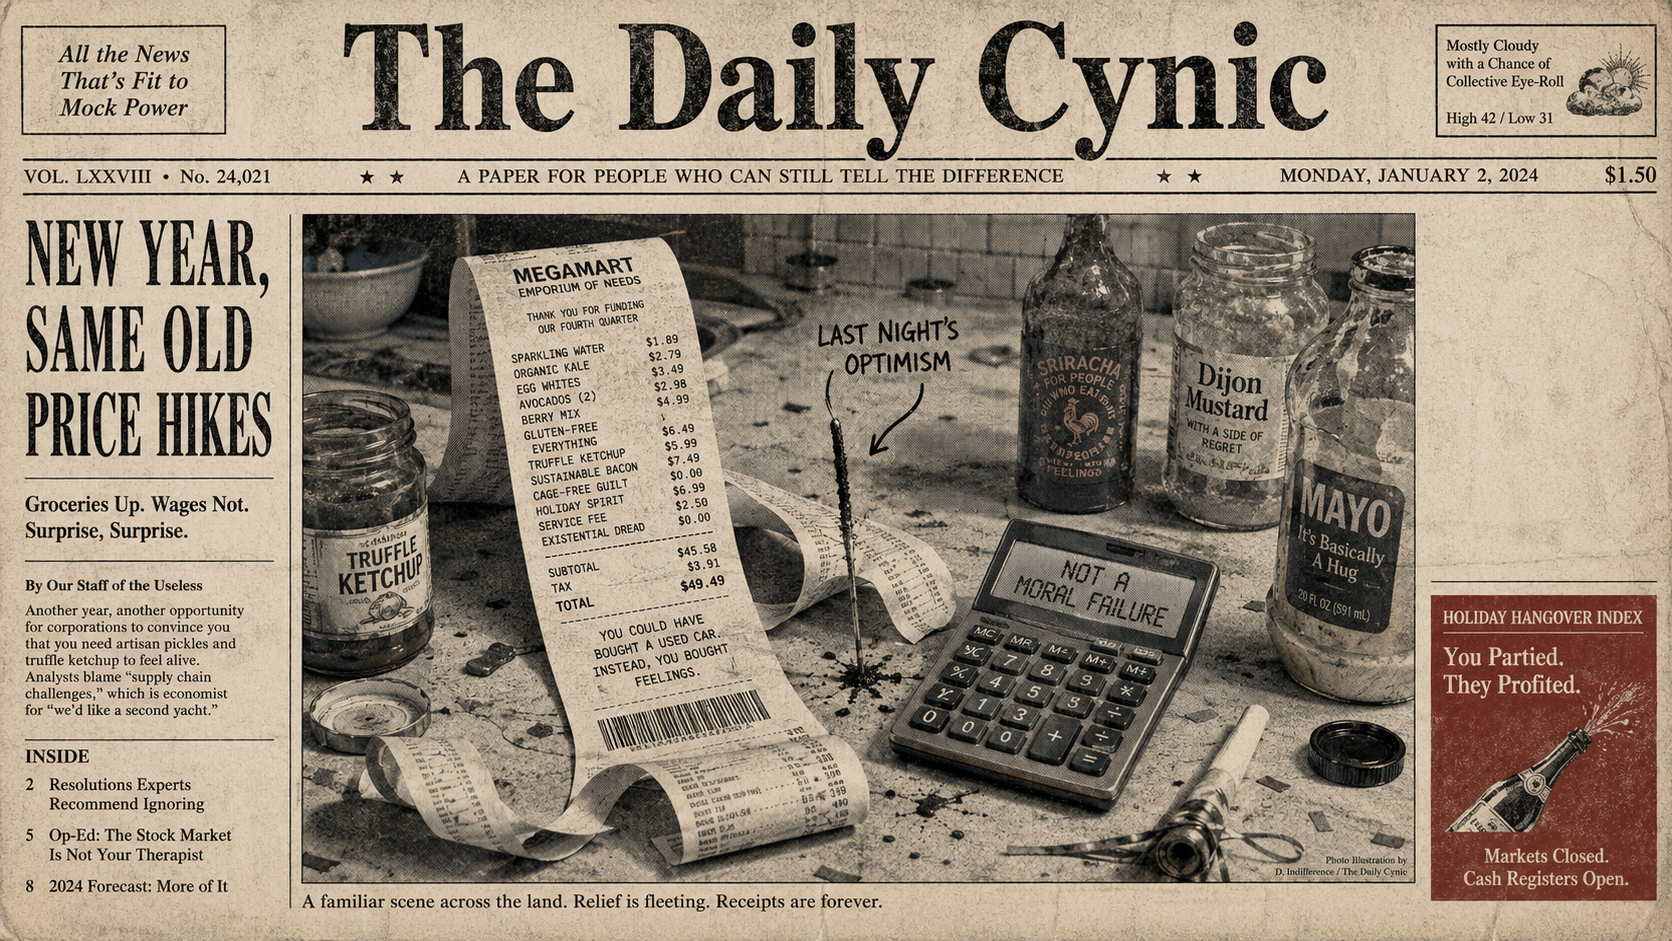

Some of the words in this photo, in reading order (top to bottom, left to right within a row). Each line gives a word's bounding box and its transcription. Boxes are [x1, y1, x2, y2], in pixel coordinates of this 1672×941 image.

[58, 44, 90, 63] All
[97, 45, 128, 63] the
[135, 45, 190, 63] News
[1447, 39, 1489, 54] Mostly
[1494, 39, 1539, 54] Cloudy
[61, 71, 125, 90] That’s
[132, 72, 162, 89] Fit
[169, 74, 188, 89] to
[344, 23, 575, 132] The
[618, 22, 935, 160] Daily
[978, 20, 1329, 160] Cynic
[1446, 75, 1507, 87] Collective
[1512, 75, 1564, 90] Eye-Roll
[59, 98, 117, 116] Mock
[123, 98, 188, 116] Power
[1447, 112, 1477, 127] High
[1481, 112, 1496, 124] 42
[1500, 112, 1505, 124] /
[1509, 112, 1535, 124] Low
[1539, 112, 1552, 124] 31
[24, 169, 68, 183] VOL.
[77, 169, 151, 183] LXXVIII
[181, 169, 209, 183] No.
[217, 169, 269, 186] 24,021
[458, 169, 470, 183] A
[479, 169, 540, 183] PAPER
[548, 169, 586, 183] FOR
[595, 169, 667, 183] PEOPLE
[675, 169, 722, 183] WHO
[730, 169, 771, 183] CAN
[780, 169, 833, 183] STILL
[840, 169, 888, 183] TELL
[895, 169, 935, 183] THE
[943, 169, 1063, 183] DIFFERENCE
[1281, 168, 1370, 184] MONDAY,
[1378, 168, 1469, 182] JANUARY
[1478, 168, 1492, 184] 2,
[1499, 168, 1538, 182] 2024
[1605, 165, 1656, 185] $1.50
[26, 220, 123, 287] NEW
[139, 219, 269, 298] YEAR,
[512, 257, 636, 285] MEGAMART
[518, 283, 581, 298] EMPORIUM
[584, 280, 599, 291] OF
[604, 275, 642, 288] NEEDS
[26, 305, 144, 373] SAME
[164, 305, 252, 373] OLD
[818, 323, 869, 347] LAST
[879, 316, 959, 343] NIGHT’S
[511, 348, 568, 364] SPARKLING
[573, 343, 605, 355] WATER
[646, 334, 678, 347] $1.89
[845, 350, 951, 375] OPTIMISM
[1037, 355, 1121, 380] SRIRACHA
[1044, 373, 1067, 389] FOR
[1070, 372, 1115, 390] PEOPLE
[1197, 361, 1262, 397] Dijon
[519, 394, 571, 410] AVOCADOS
[578, 390, 596, 404] (2)
[654, 379, 687, 392] $2.98
[1184, 385, 1269, 421] Mustard
[26, 392, 141, 457] PRICE
[156, 391, 272, 457] HIKES
[524, 421, 598, 440] GLUTEN-FREE
[1186, 417, 1210, 434] WITH
[1212, 426, 1219, 437] A
[1223, 428, 1246, 440] SIDE
[1250, 431, 1264, 441] OF
[532, 436, 597, 454] EVERYTHING
[662, 423, 694, 436] $6.49
[1202, 437, 1243, 454] REGRET
[25, 496, 108, 512] Groceries
[114, 496, 144, 517] Up.
[151, 496, 206, 517] Wages
[212, 496, 248, 512] Not.
[1300, 476, 1392, 538] MAYO
[26, 522, 103, 543] Surprise,
[110, 522, 188, 543] Surprise.
[542, 528, 610, 547] EXISTENTIAL
[614, 522, 645, 535] DREAD
[678, 512, 711, 526] $0.00
[346, 535, 417, 569] TRUFFLE
[1298, 524, 1317, 546] It’s
[1319, 533, 1385, 569] Basically
[548, 562, 600, 578] SUBTOTAL
[677, 542, 717, 558] $45.58
[1312, 552, 1323, 570] A
[1326, 557, 1360, 583] Hug
[338, 552, 423, 595] KETCHUP
[1061, 559, 1106, 586] NOT
[1113, 571, 1131, 592] A
[26, 580, 42, 594] By
[47, 580, 73, 591] Our
[77, 579, 109, 591] Staff
[112, 579, 126, 591] of
[129, 579, 150, 591] the
[154, 580, 203, 591] Useless
[555, 597, 594, 612] TOTAL
[680, 575, 725, 593] $49.49
[1013, 575, 1076, 608] MORAL
[1086, 592, 1169, 628] FAILURE
[1298, 588, 1308, 602] 20
[1309, 593, 1318, 607] FL
[1319, 598, 1332, 611] OZ
[25, 604, 78, 616] Another
[82, 608, 112, 619] year,
[116, 604, 166, 616] another
[170, 604, 244, 619] opportunity
[1443, 610, 1507, 624] HOLIDAY
[1511, 610, 1592, 624] HANGOVER
[1597, 610, 1642, 624] INDEX
[599, 628, 623, 641] YOU
[629, 620, 667, 636] COULD
[673, 614, 704, 628] HAVE
[974, 626, 997, 638] MC
[1010, 635, 1033, 647] MR
[1443, 647, 1481, 666] You
[1488, 647, 1563, 666] Partied.
[635, 667, 700, 687] FEELINGS.
[1443, 674, 1491, 699] They
[1498, 674, 1580, 694] Profited.
[26, 749, 89, 763] INSIDE
[26, 778, 34, 791] 2
[50, 778, 132, 791] Resolutions
[137, 778, 191, 794] Experts
[1326, 856, 1350, 865] Photo
[1352, 856, 1395, 865] Illustration
[1398, 856, 1407, 866] by
[1484, 848, 1548, 863] Markets
[1553, 848, 1609, 863] Closed.
[26, 880, 34, 892] 8
[49, 880, 83, 892] 2024
[88, 880, 151, 892] Forecast:
[157, 880, 194, 892] More
[199, 879, 214, 892] of
[217, 880, 228, 892] It
[1464, 870, 1501, 886] Cash
[1507, 870, 1578, 890] Registers
[1583, 870, 1629, 890] Open.
[302, 894, 315, 908] A
[321, 894, 385, 908] familiar
[391, 898, 434, 908] scene
[440, 898, 490, 908] across
[496, 894, 521, 908] the
[528, 894, 567, 908] land.
[574, 894, 622, 908] Relief
[627, 894, 639, 908] is
[645, 894, 710, 912] fleeting.
[716, 894, 785, 912] Receipts
[791, 898, 815, 908] are
[821, 894, 882, 908] forever.
